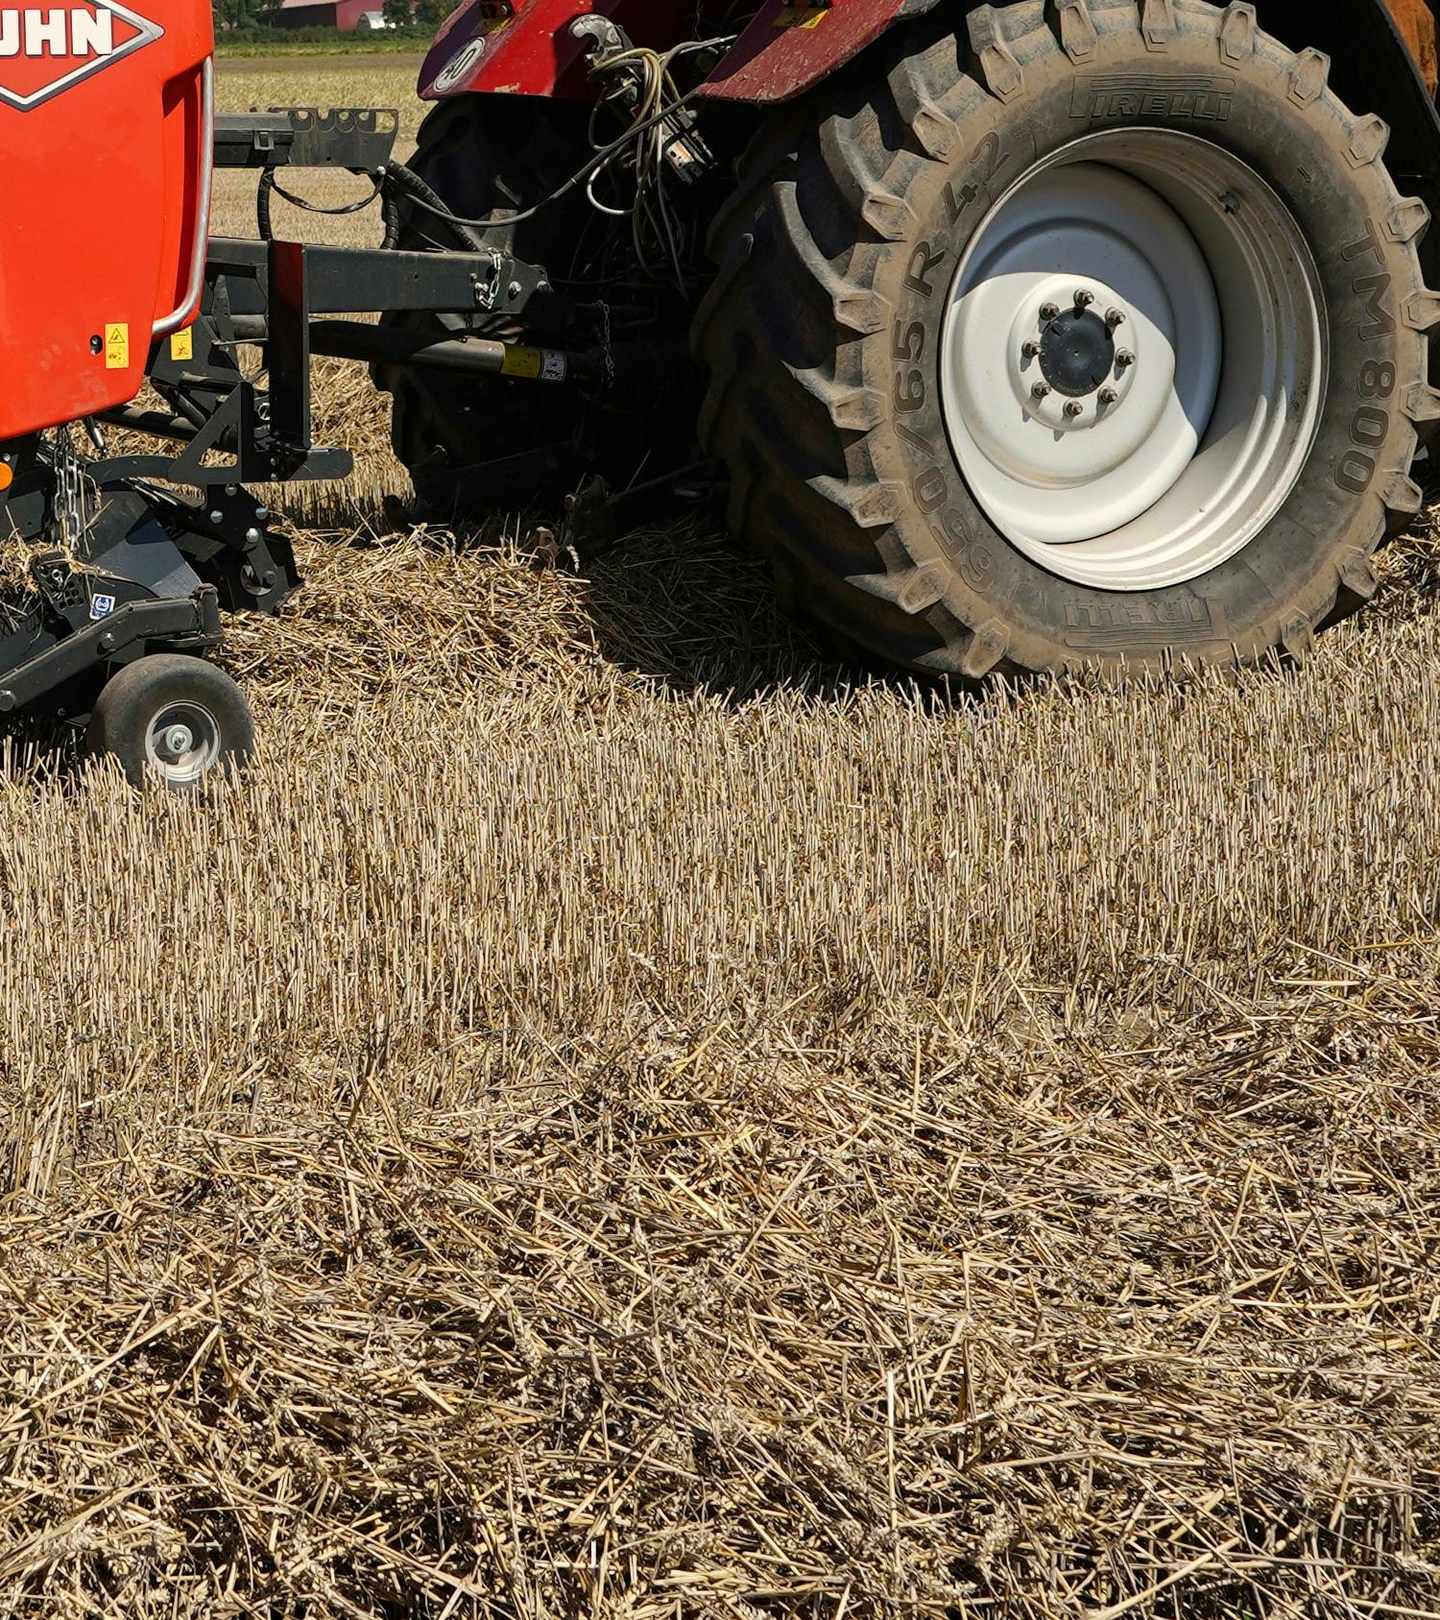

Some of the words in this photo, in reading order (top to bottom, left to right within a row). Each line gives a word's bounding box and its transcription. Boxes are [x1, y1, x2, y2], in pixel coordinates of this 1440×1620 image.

[1070, 73, 1236, 121] PIRELLI
[904, 240, 945, 300] R
[942, 131, 1010, 227] 42
[1341, 217, 1398, 341] TM
[1334, 358, 1397, 496] 800
